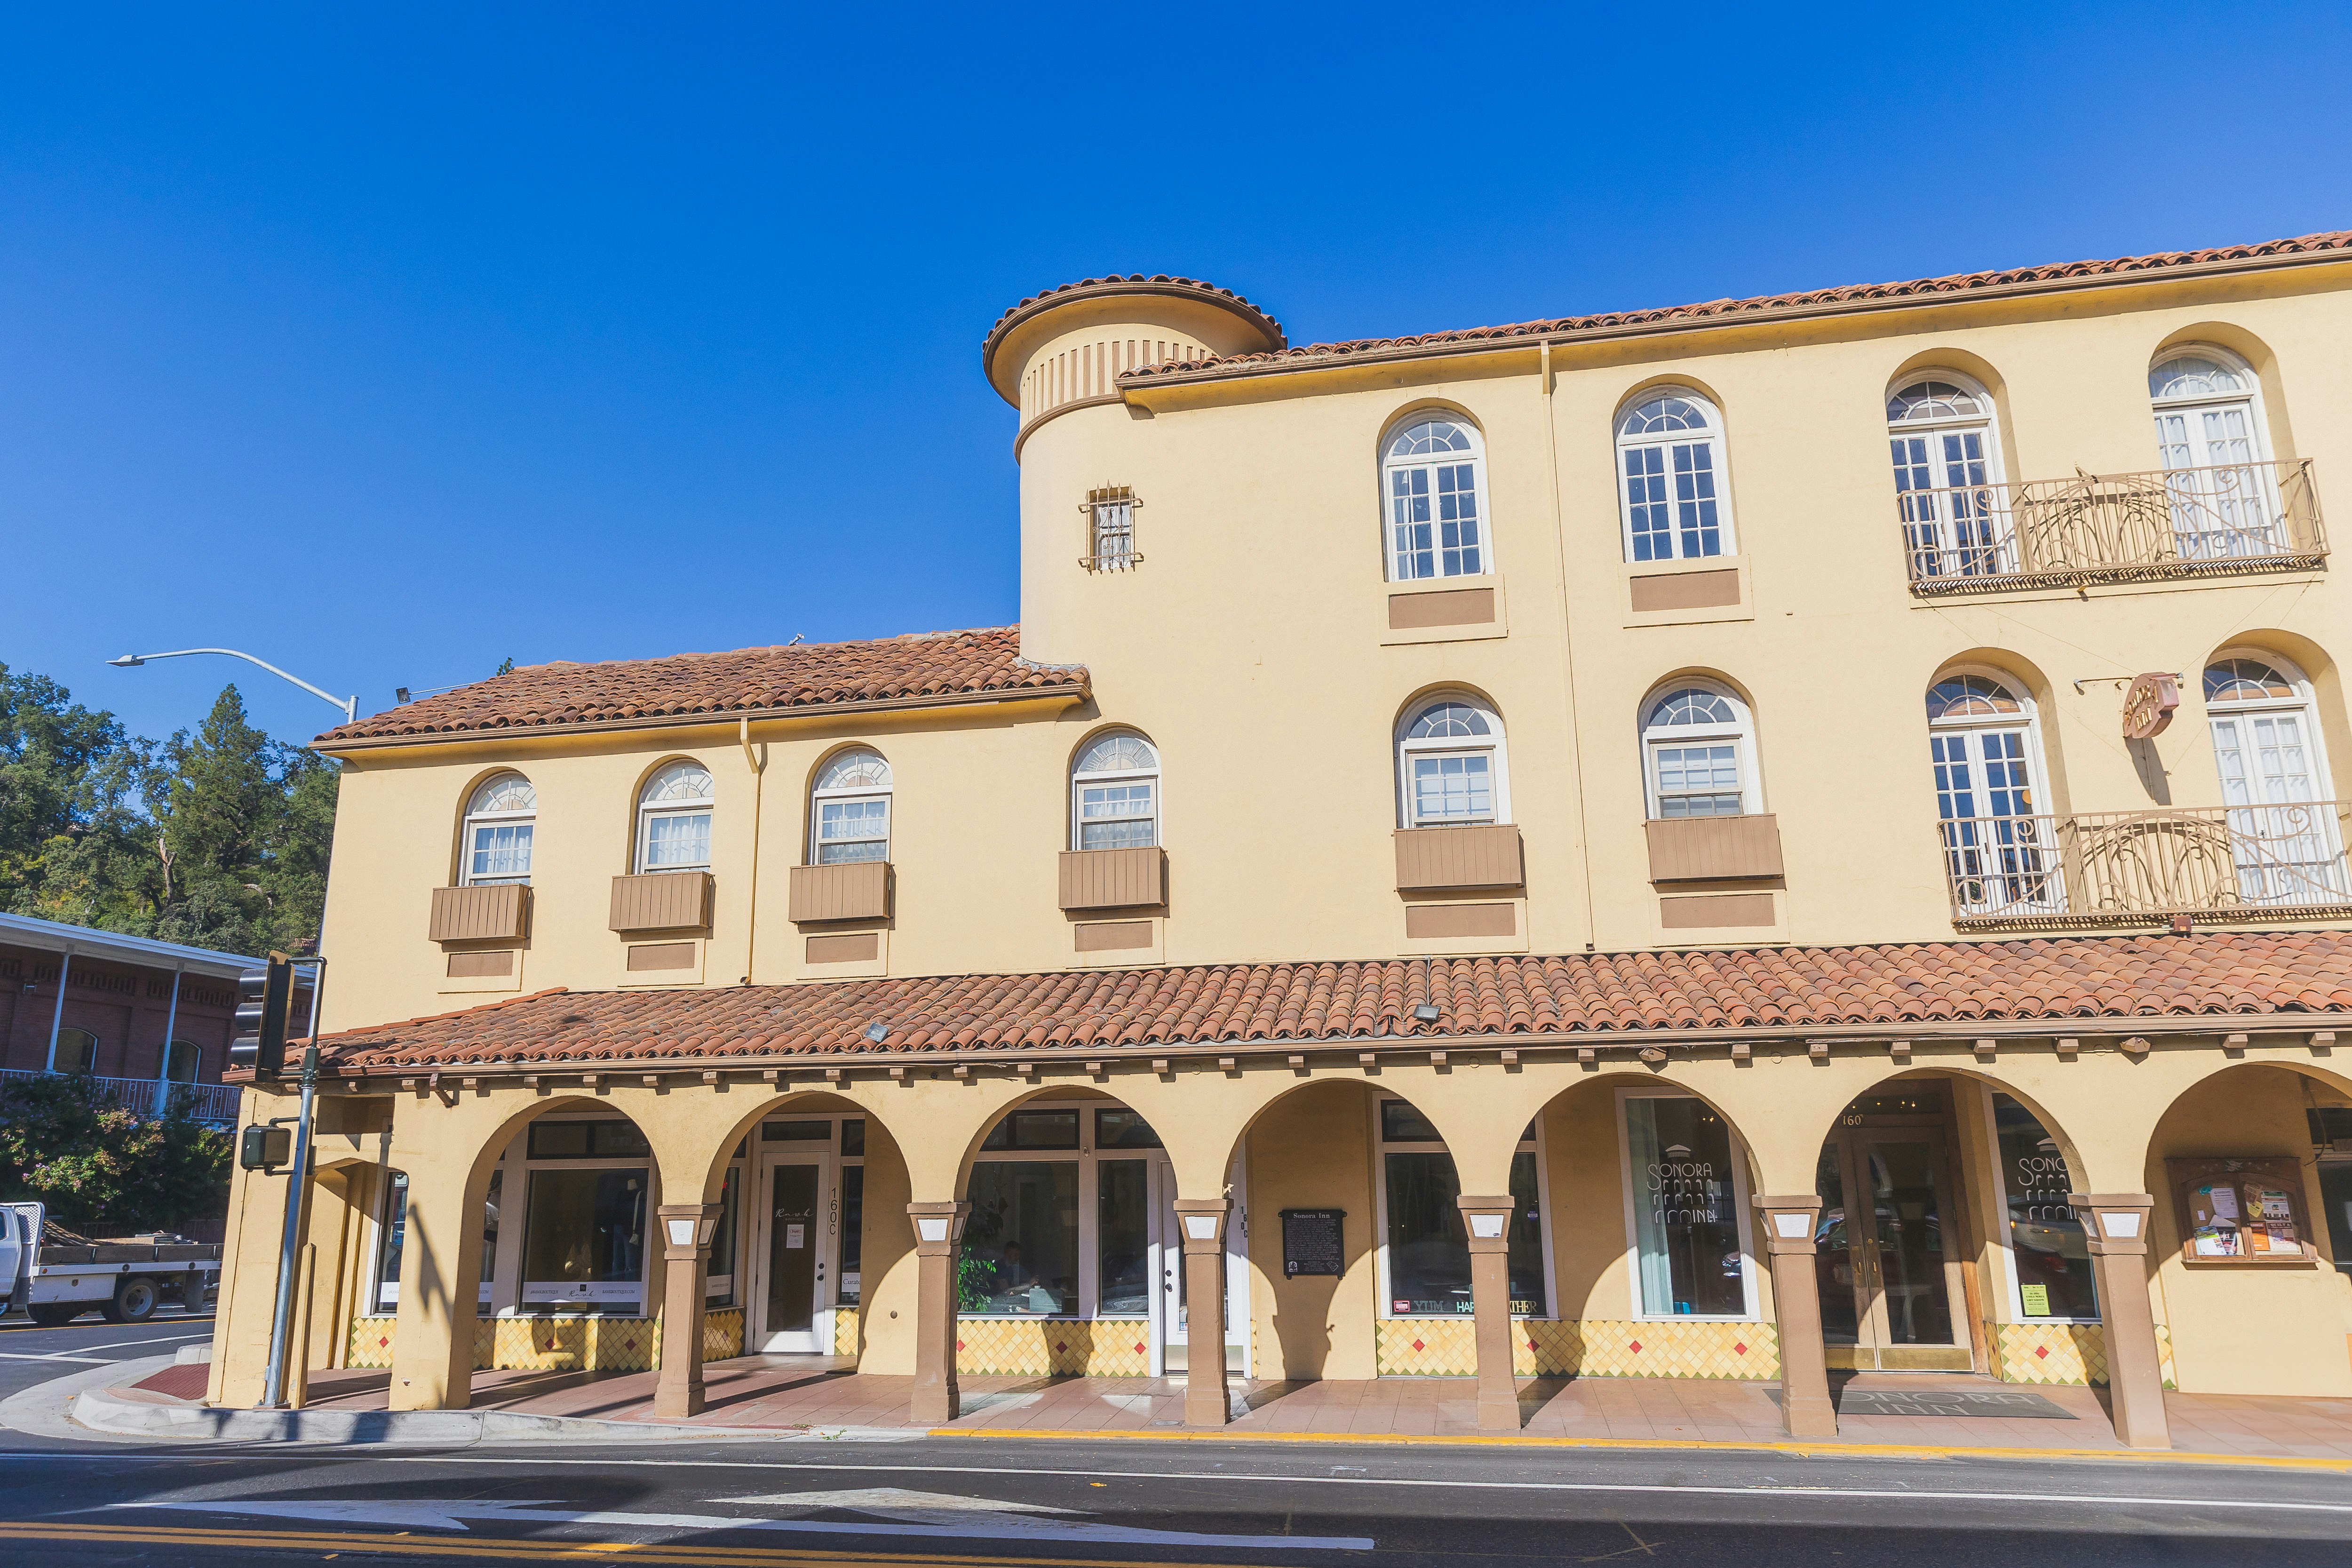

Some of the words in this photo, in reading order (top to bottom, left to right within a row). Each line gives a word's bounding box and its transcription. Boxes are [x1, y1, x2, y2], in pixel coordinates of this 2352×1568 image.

[2124, 685, 2159, 726] SONORA
[2136, 705, 2152, 731] INN
[1843, 1115, 1861, 1125] 160
[1647, 1163, 1712, 1190] SONORA
[1692, 1209, 1716, 1223] INN
[1414, 1300, 1444, 1312] YUM
[1874, 1403, 1970, 1416] INN
